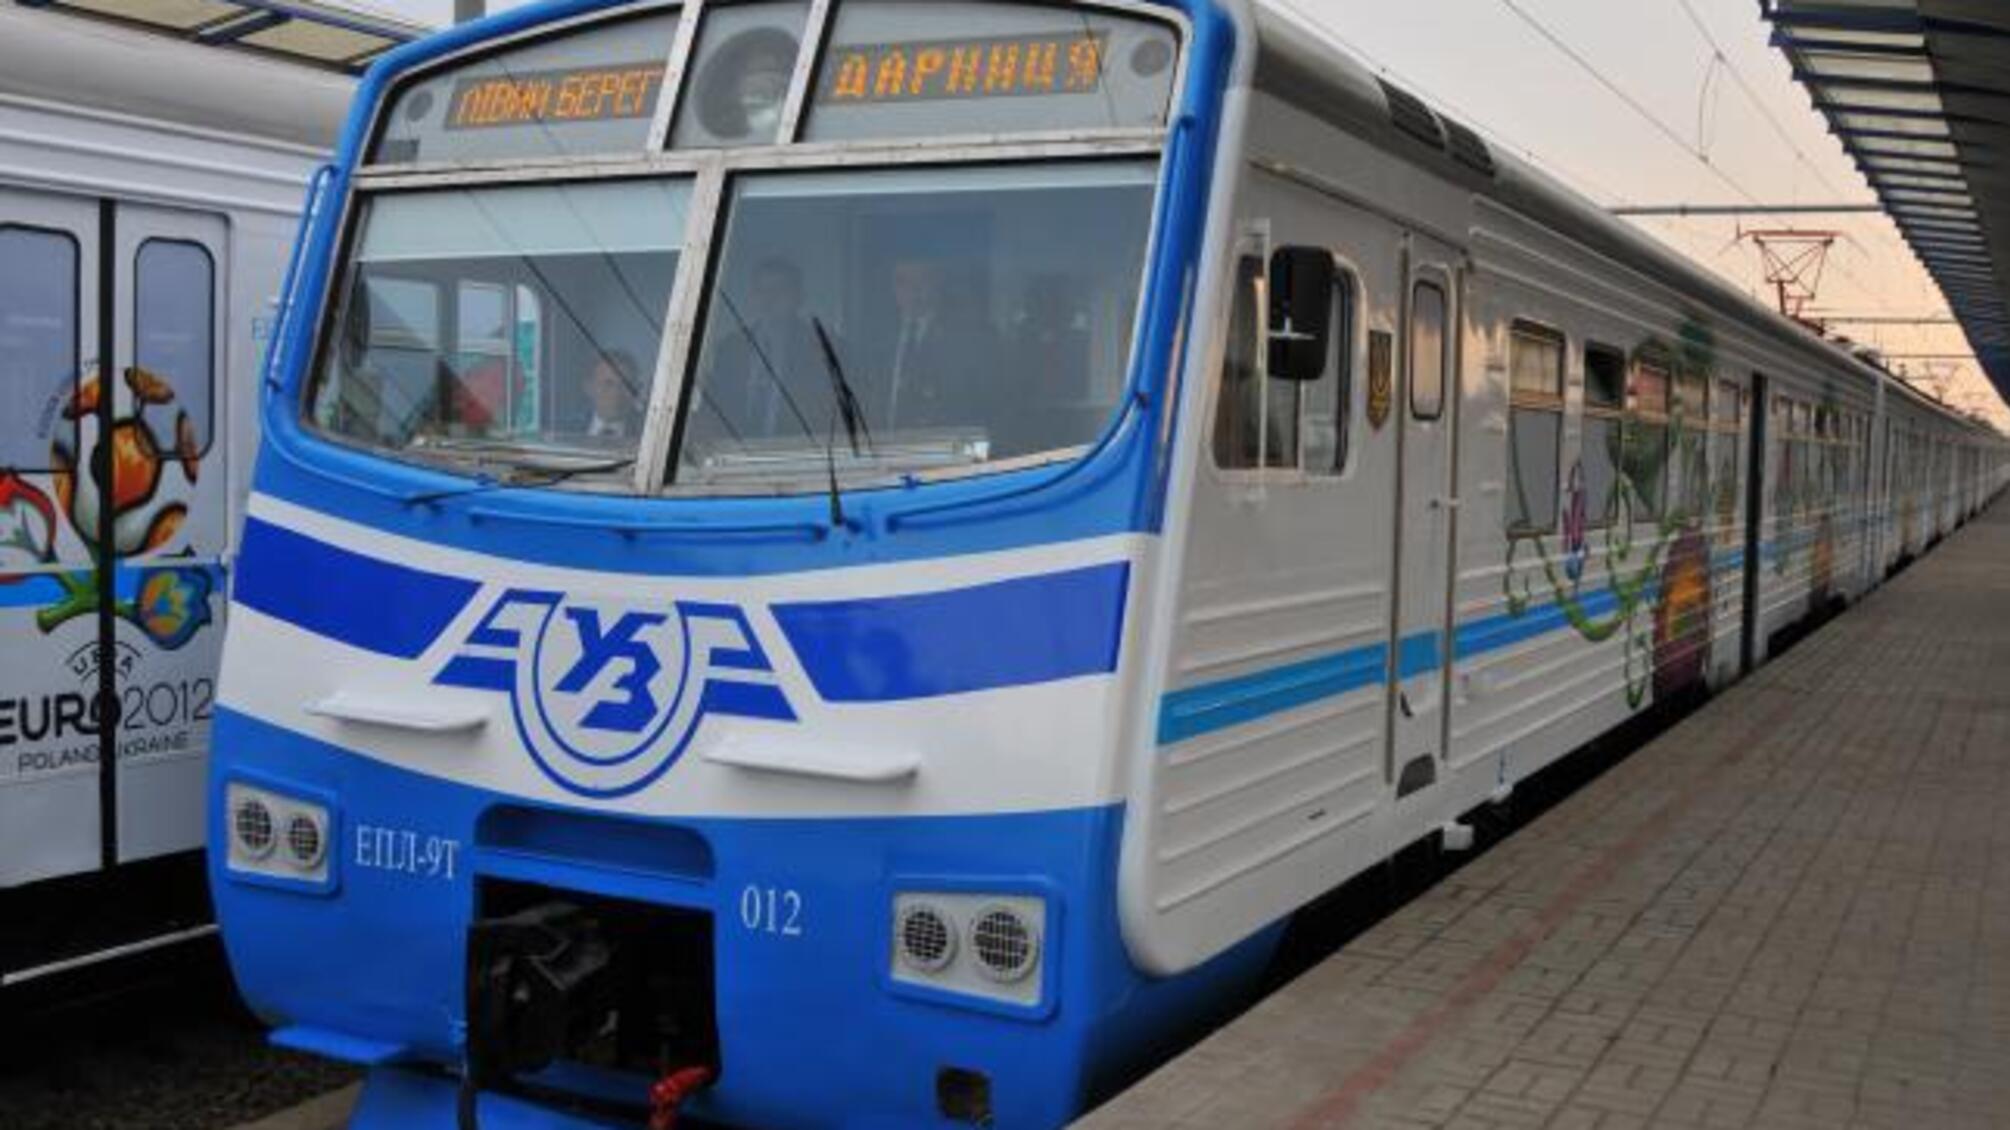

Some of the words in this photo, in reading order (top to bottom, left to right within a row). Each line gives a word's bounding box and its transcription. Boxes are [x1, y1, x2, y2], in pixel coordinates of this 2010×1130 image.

[554, 69, 664, 118] БЕРЕГ
[73, 649, 133, 675] UEA
[123, 677, 213, 731] 2012
[355, 825, 460, 879] ЕПЛ-9Т
[740, 885, 801, 935] 012
